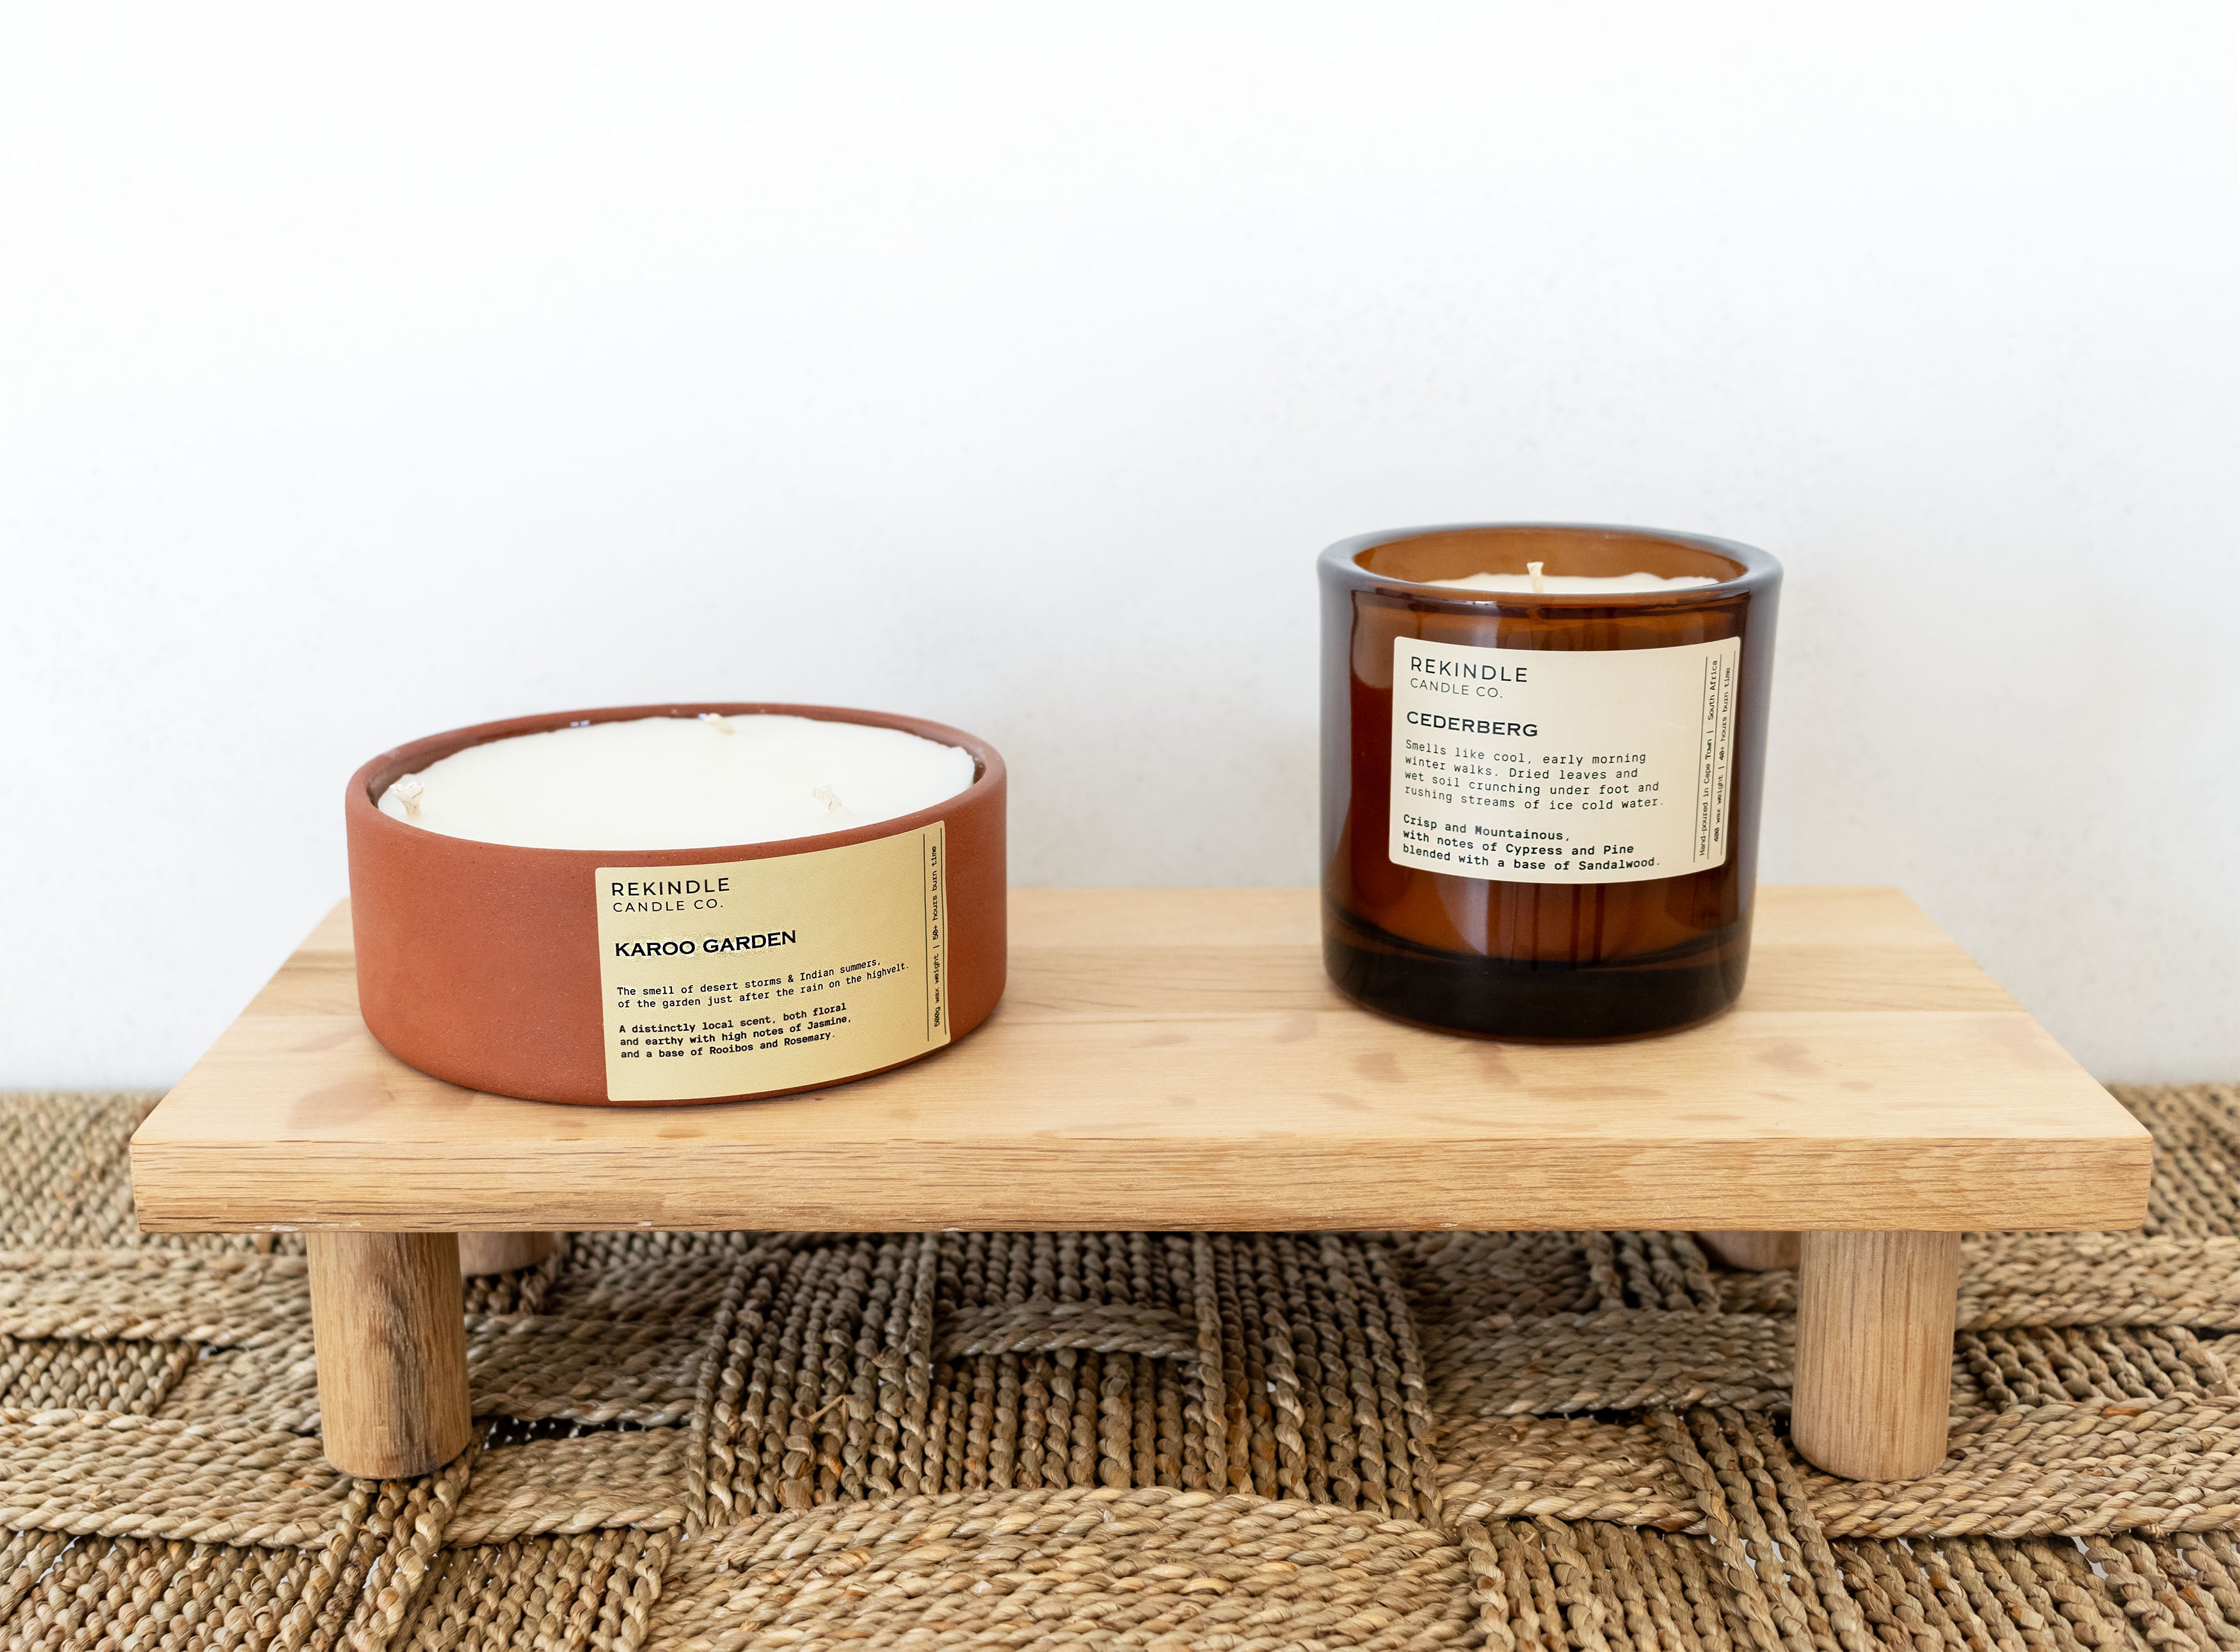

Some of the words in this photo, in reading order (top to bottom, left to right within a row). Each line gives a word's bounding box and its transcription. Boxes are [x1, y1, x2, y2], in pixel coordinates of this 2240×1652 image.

[1410, 656, 1528, 683] REKINDLE
[1709, 660, 1718, 690] Africa
[1410, 678, 1469, 695] CANDLE
[1476, 686, 1503, 699] CO.
[1407, 711, 1538, 737] CEDERBERG
[1405, 739, 1446, 755] Smells
[1455, 747, 1485, 760] like
[1494, 752, 1531, 765] cool,
[1542, 754, 1583, 766] early
[1592, 753, 1646, 764] morning
[1405, 756, 1446, 770] winter
[1453, 764, 1498, 776] walks.
[1509, 768, 1549, 779] Dried
[1559, 770, 1606, 780] leaves
[1615, 768, 1638, 779] and
[1703, 763, 1711, 784] Cape
[1405, 771, 1424, 782] wet
[1432, 776, 1460, 788] soil
[1469, 781, 1540, 797] crunching
[1550, 785, 1590, 795] under
[1599, 784, 1629, 795] foot
[1638, 781, 1659, 793] and
[1702, 787, 1709, 797] in
[1405, 786, 1452, 804] rushing
[1461, 795, 1515, 808] streams
[1524, 799, 1540, 809] of
[1549, 800, 1573, 810] ice
[1582, 799, 1613, 810] cold
[1621, 797, 1664, 809] water.
[1404, 814, 1437, 831] Crisp
[1444, 823, 1466, 834] and
[1475, 825, 1569, 841] Mountainous,
[1699, 802, 1708, 856] Hand-poured
[1403, 830, 1429, 843] with
[1437, 837, 1474, 849] notes
[1482, 842, 1498, 852] of
[1505, 843, 1562, 857] Cypress
[1571, 845, 1595, 855] and
[1603, 844, 1634, 855] Pine
[1403, 843, 1451, 861] blended
[1458, 854, 1489, 866] with
[1514, 859, 1546, 870] base
[1554, 861, 1570, 870] of
[1578, 857, 1661, 871] Sandalwood.
[611, 877, 730, 896] REKINDLE
[612, 900, 685, 912] CANDLE
[694, 898, 723, 910] CO.
[615, 941, 696, 957] KAROO
[702, 930, 796, 953] GARDEN
[616, 987, 636, 996] The
[643, 986, 675, 996] smell
[680, 985, 694, 994] of
[700, 981, 739, 992] desert
[744, 978, 782, 989] storms
[787, 974, 794, 983] &
[800, 969, 835, 981] Indian
[840, 959, 882, 974] summers,
[618, 999, 630, 1008] of
[636, 999, 656, 1008] the
[662, 997, 701, 1009] garden
[707, 994, 733, 1006] just
[739, 992, 770, 1002] after
[776, 988, 794, 997] the
[800, 983, 824, 994] rain
[829, 980, 840, 989] on
[845, 975, 862, 985] the
[867, 961, 910, 981] highvelt.
[619, 1024, 626, 1033] A
[632, 1023, 696, 1033] distinctly
[702, 1019, 734, 1030] local
[783, 1010, 807, 1021] both
[813, 1002, 847, 1017] floral
[620, 1037, 639, 1045] and
[645, 1036, 684, 1047] earthy
[689, 1034, 716, 1044] with
[721, 1031, 747, 1042] high
[753, 1028, 784, 1038] notes
[789, 1022, 801, 1033] of
[807, 1016, 851, 1030] Jasmine,
[621, 1049, 640, 1058] and
[659, 1049, 684, 1058] base
[690, 1047, 703, 1056] of
[709, 1044, 754, 1055] Rooibos
[760, 1039, 778, 1049] and
[784, 1031, 835, 1046] Rosemary.
